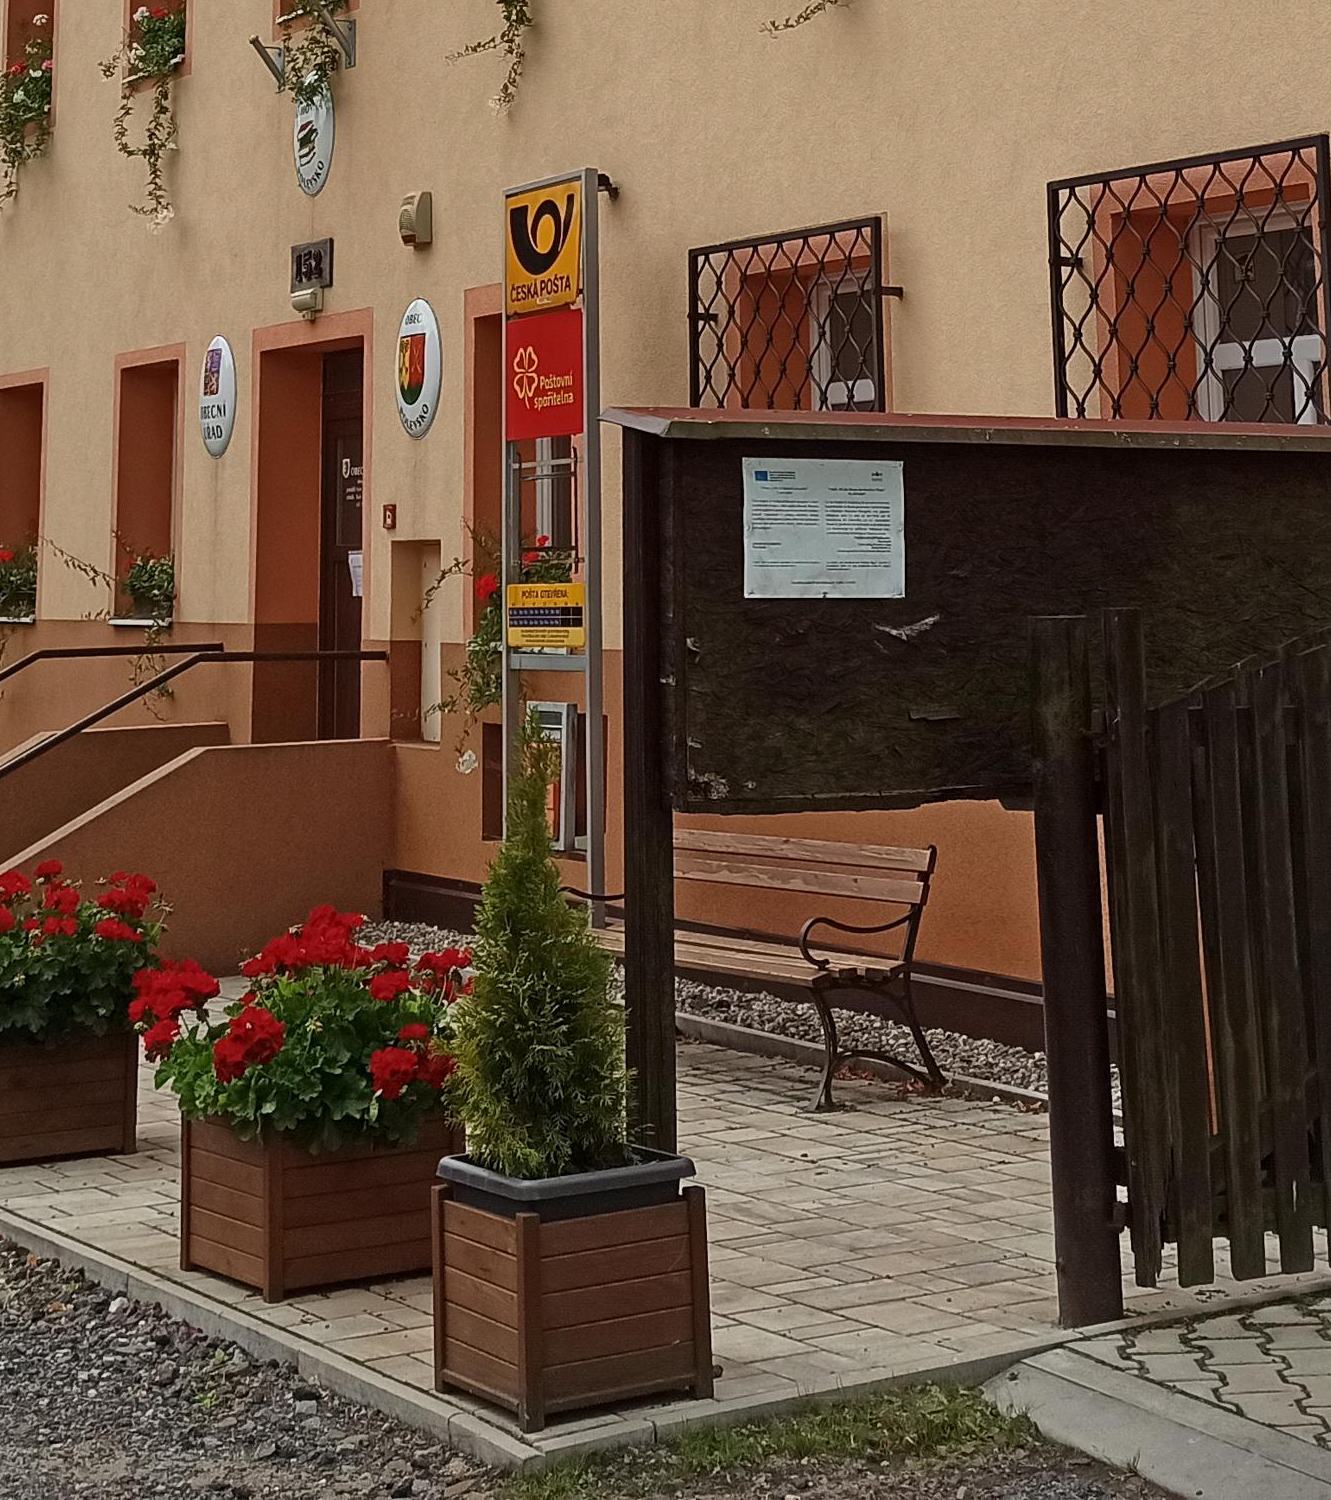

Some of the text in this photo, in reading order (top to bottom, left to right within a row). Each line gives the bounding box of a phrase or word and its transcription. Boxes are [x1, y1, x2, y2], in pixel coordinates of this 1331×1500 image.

[295, 250, 323, 283] 152
[510, 274, 571, 303] ČESKÁ POŠTA
[405, 313, 423, 325] OBEC
[540, 370, 573, 390] Poštovní
[534, 390, 574, 411] spořitelna
[522, 588, 538, 599] POŠTA
